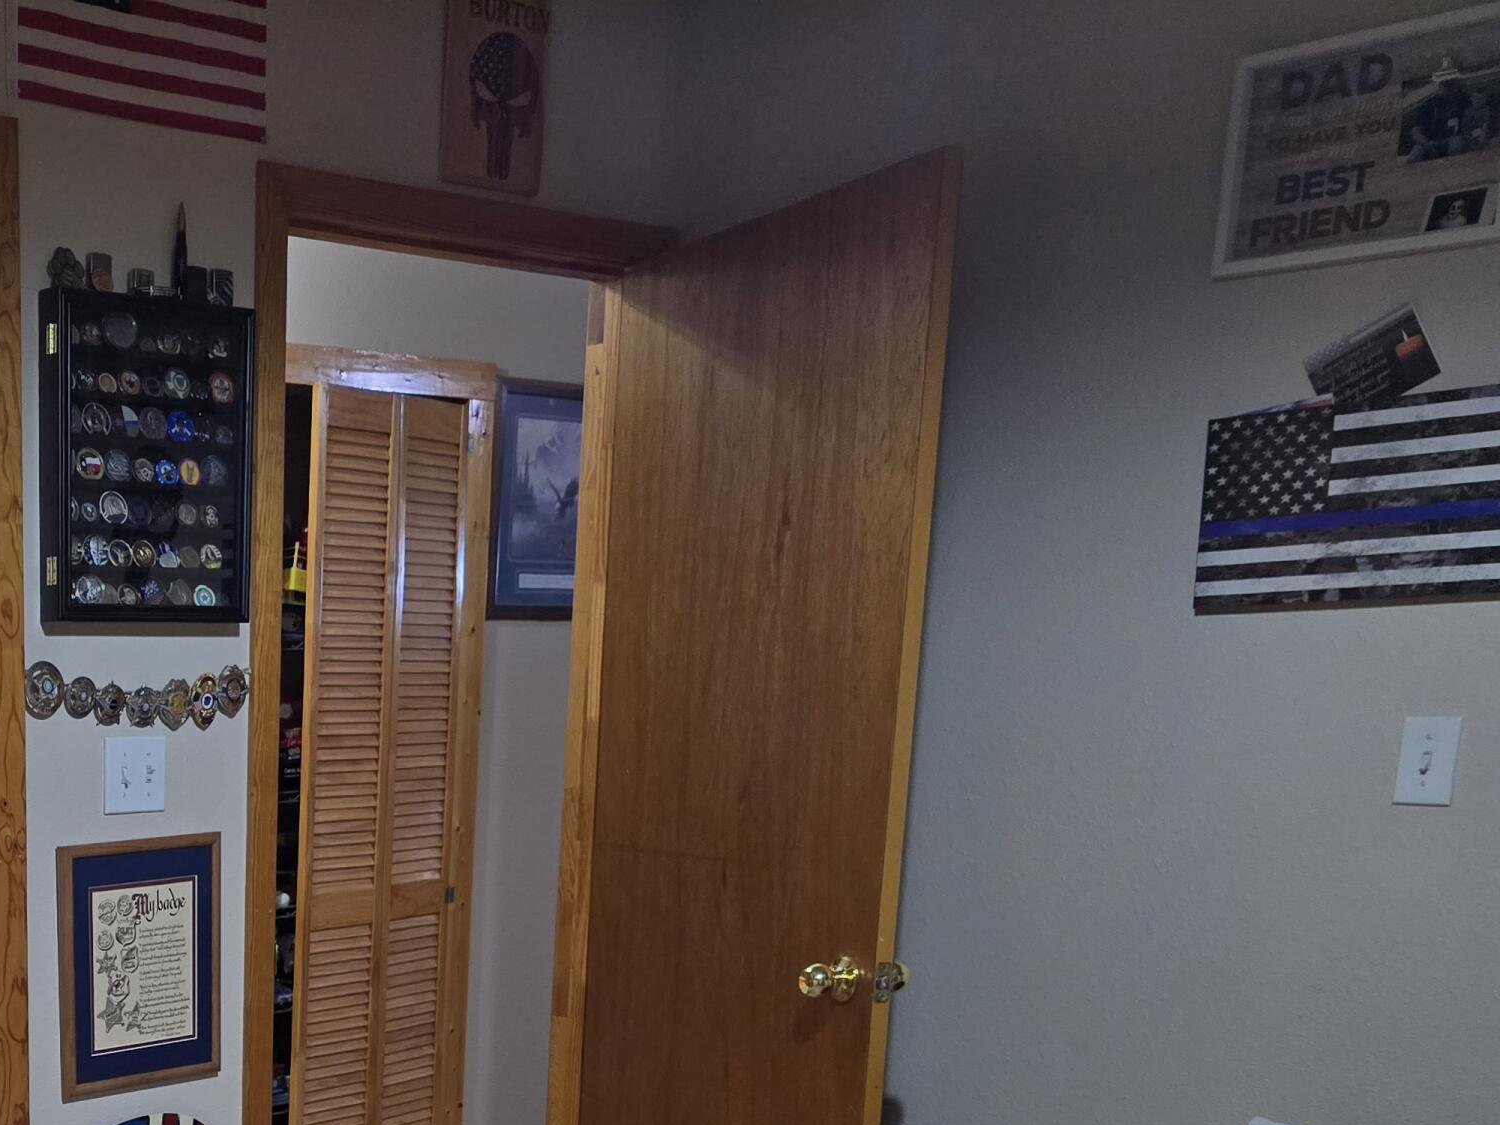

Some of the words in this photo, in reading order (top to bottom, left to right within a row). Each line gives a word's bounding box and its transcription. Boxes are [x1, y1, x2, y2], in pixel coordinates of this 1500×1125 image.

[1281, 53, 1393, 109] DAD
[1297, 127, 1348, 146] HAVE
[1353, 117, 1398, 137] YOU
[1274, 161, 1375, 205] BEST
[1250, 199, 1391, 248] FRIEND
[132, 893, 155, 922] My
[156, 888, 186, 917] badge
